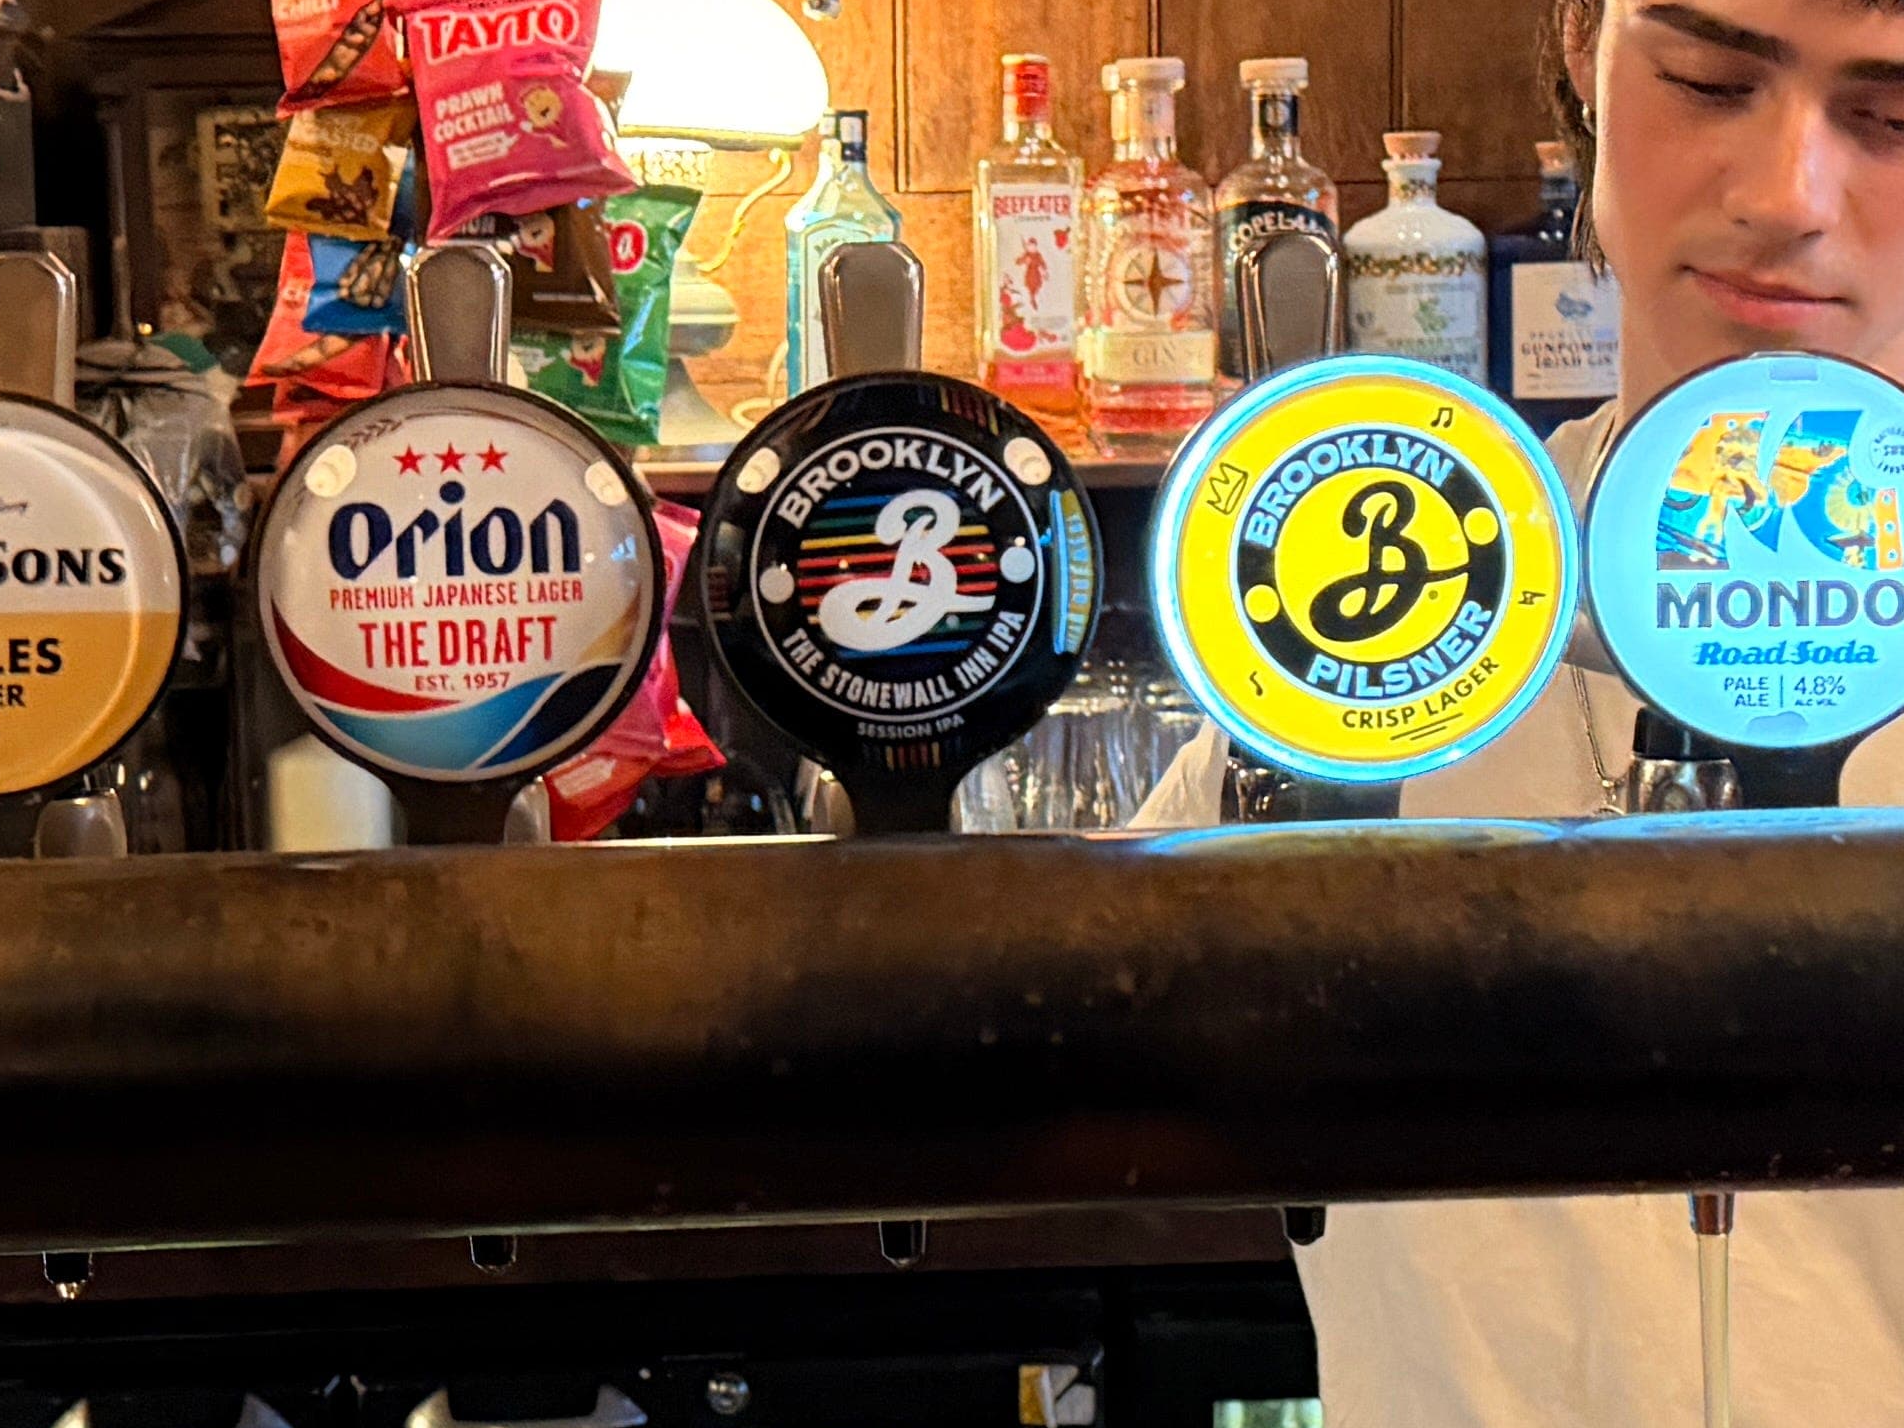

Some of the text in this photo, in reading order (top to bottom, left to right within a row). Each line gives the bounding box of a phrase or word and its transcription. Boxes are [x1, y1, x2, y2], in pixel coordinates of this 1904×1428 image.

[415, 0, 580, 65] TAYTO
[435, 81, 505, 119] PRAWN
[432, 102, 515, 143] COCKTAIL
[994, 194, 1072, 218] BEEFEATER
[1133, 339, 1177, 366] GIN
[776, 437, 1007, 531] BROOKLYN
[1245, 433, 1456, 549] BROOKLYN
[328, 480, 583, 581] Orion
[329, 579, 584, 611] PREMIUM JAPANESE LAGER
[358, 615, 558, 669] THE DRAFT
[781, 610, 1026, 711] THE STONEWALL INN IPA
[1306, 599, 1494, 698] PILSNER
[1695, 639, 1879, 667] Road Soda
[415, 672, 511, 693] EST. 1957
[1342, 655, 1500, 730] CRISP LAGER
[1723, 675, 1846, 696] PALE 4.8%
[1734, 693, 1770, 707] ALE
[856, 712, 965, 739] SESSION IPA
